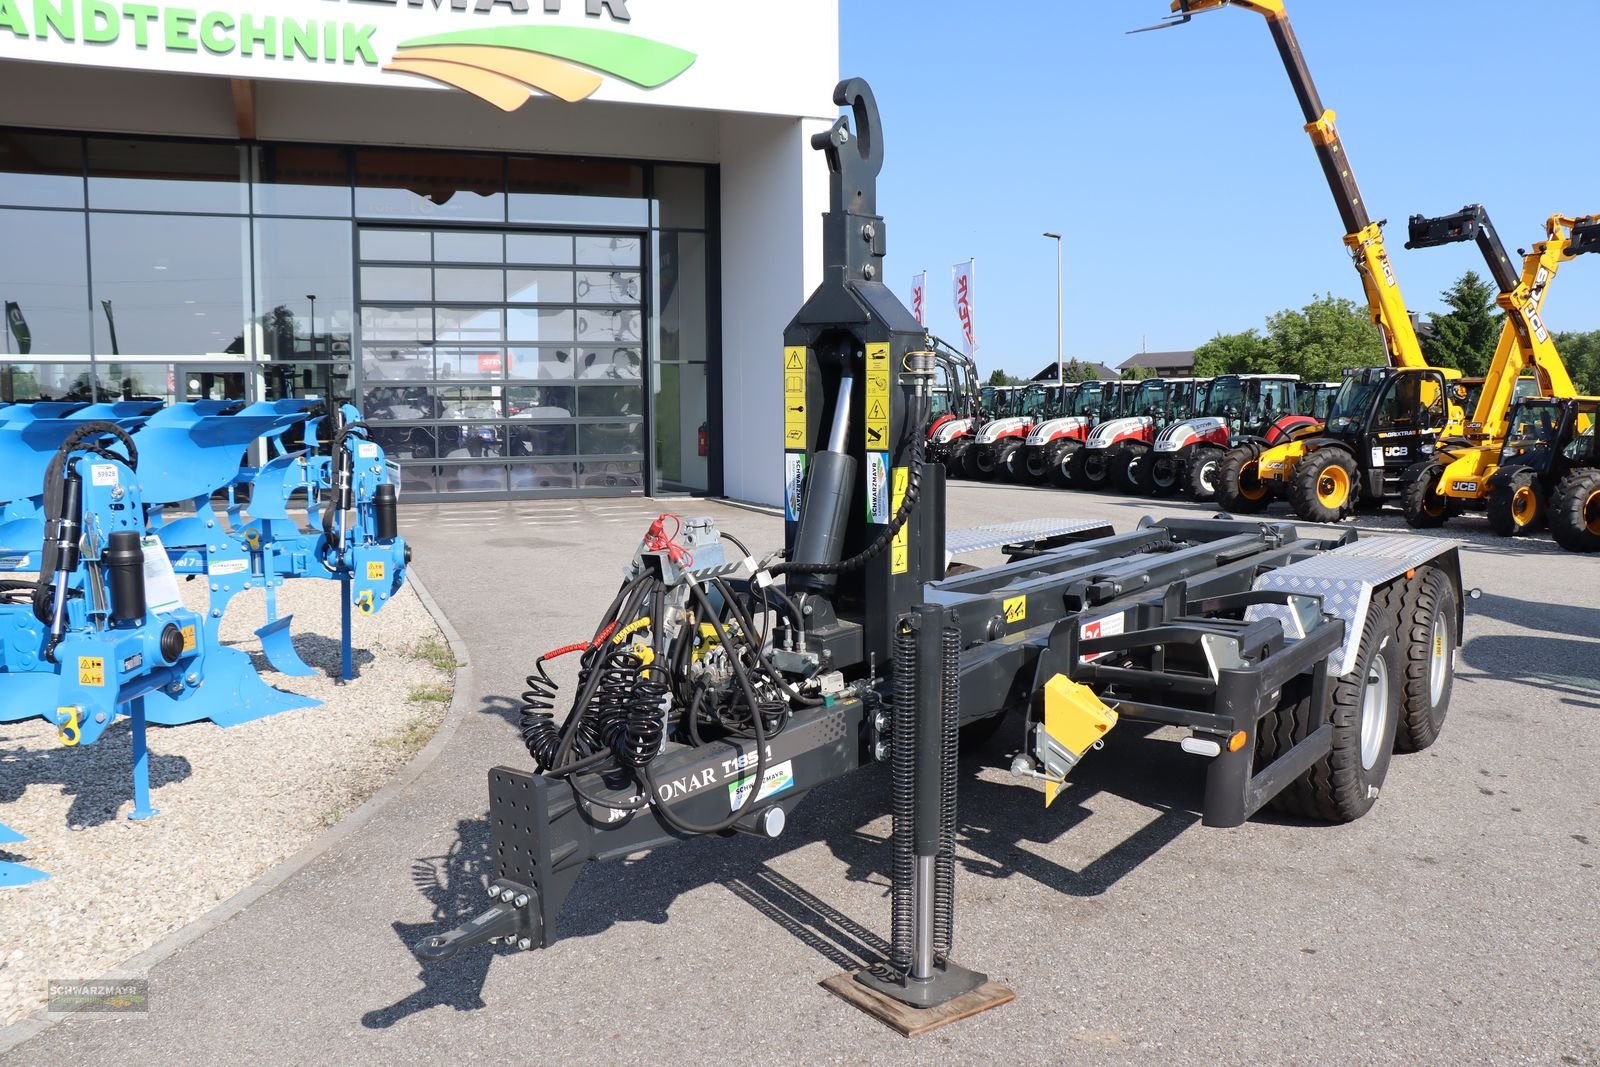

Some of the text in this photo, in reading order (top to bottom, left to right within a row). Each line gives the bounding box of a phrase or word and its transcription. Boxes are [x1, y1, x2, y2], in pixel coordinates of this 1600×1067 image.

[1524, 303, 1549, 344] JCB
[1385, 446, 1408, 456] JCB
[1452, 481, 1477, 492] JCB
[629, 745, 772, 813] PONAR T1851
